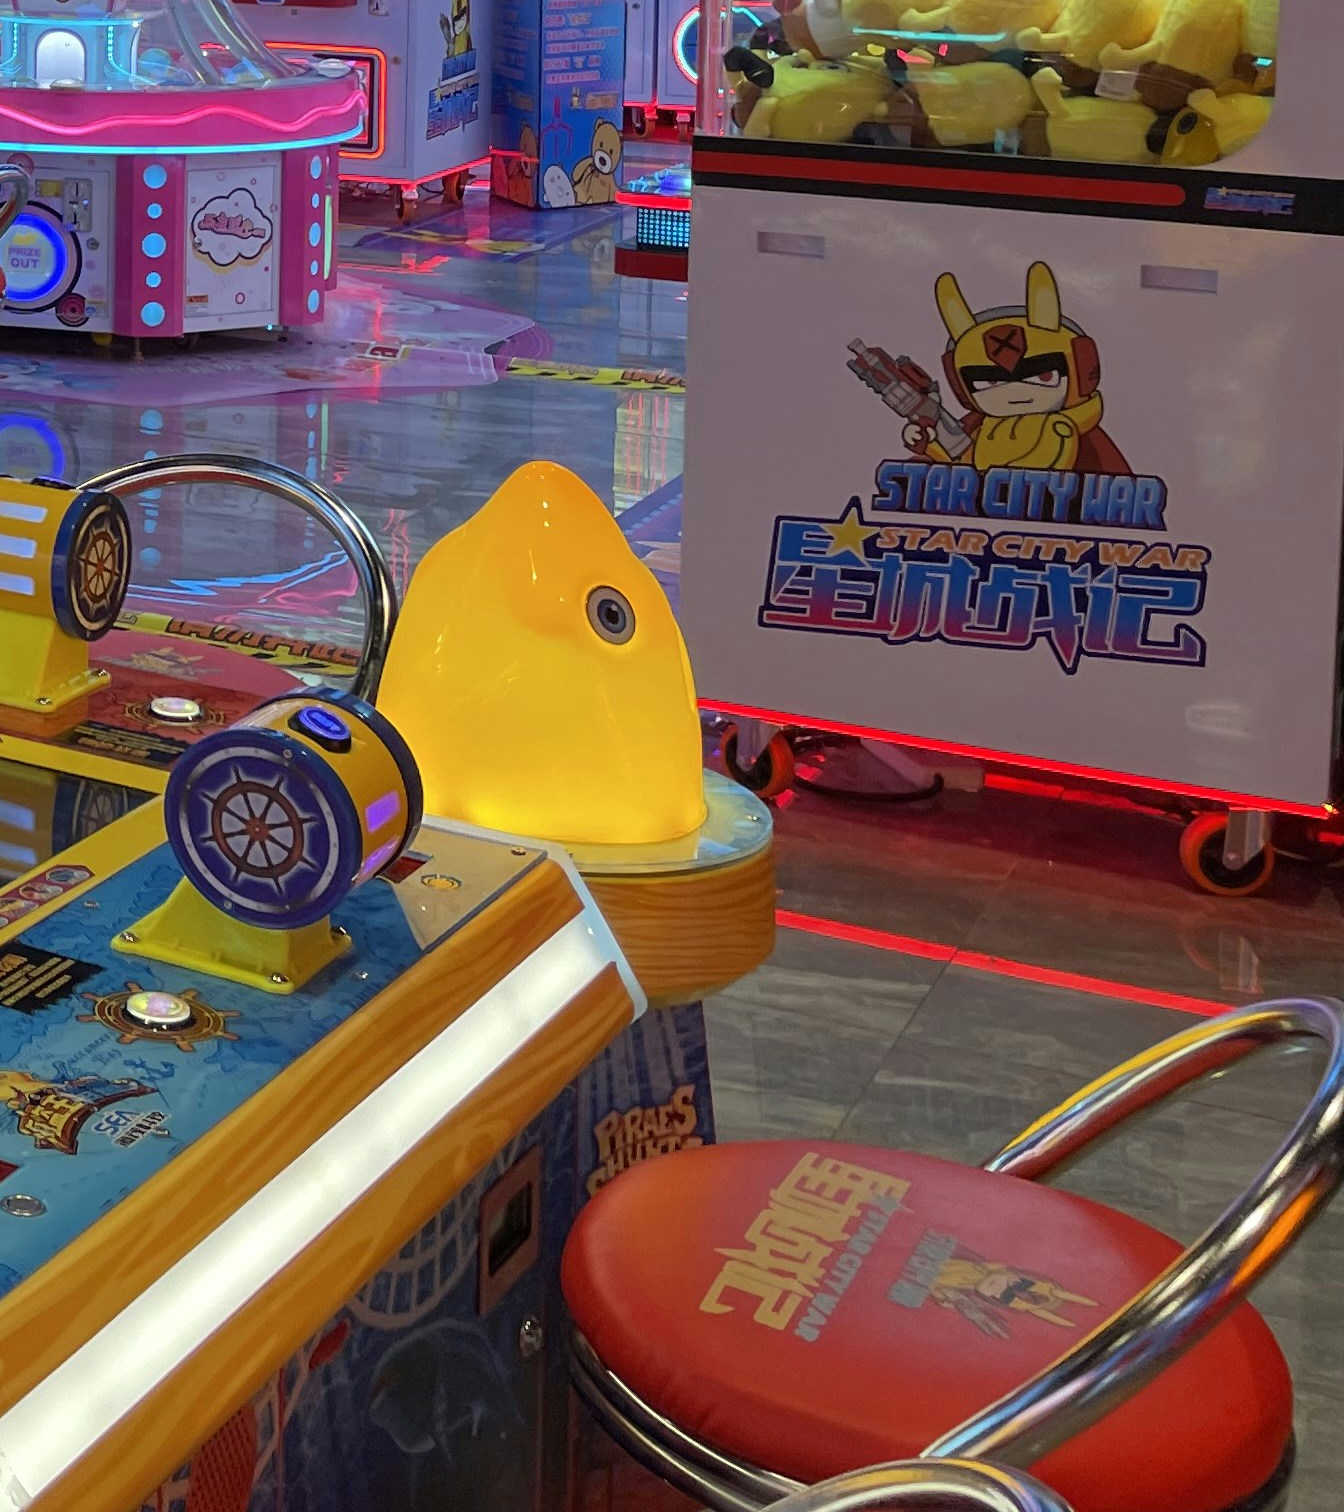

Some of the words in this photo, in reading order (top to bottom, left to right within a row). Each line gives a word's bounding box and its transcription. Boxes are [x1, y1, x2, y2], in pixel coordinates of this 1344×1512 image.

[11, 259, 39, 269] OUT
[875, 463, 979, 515] STAR
[982, 469, 1080, 522] CITY
[1080, 474, 1166, 528] WAR
[876, 527, 989, 555] STAR
[992, 535, 1094, 563] CITY
[1098, 543, 1210, 572] WAR
[763, 520, 1206, 672] 星城战记
